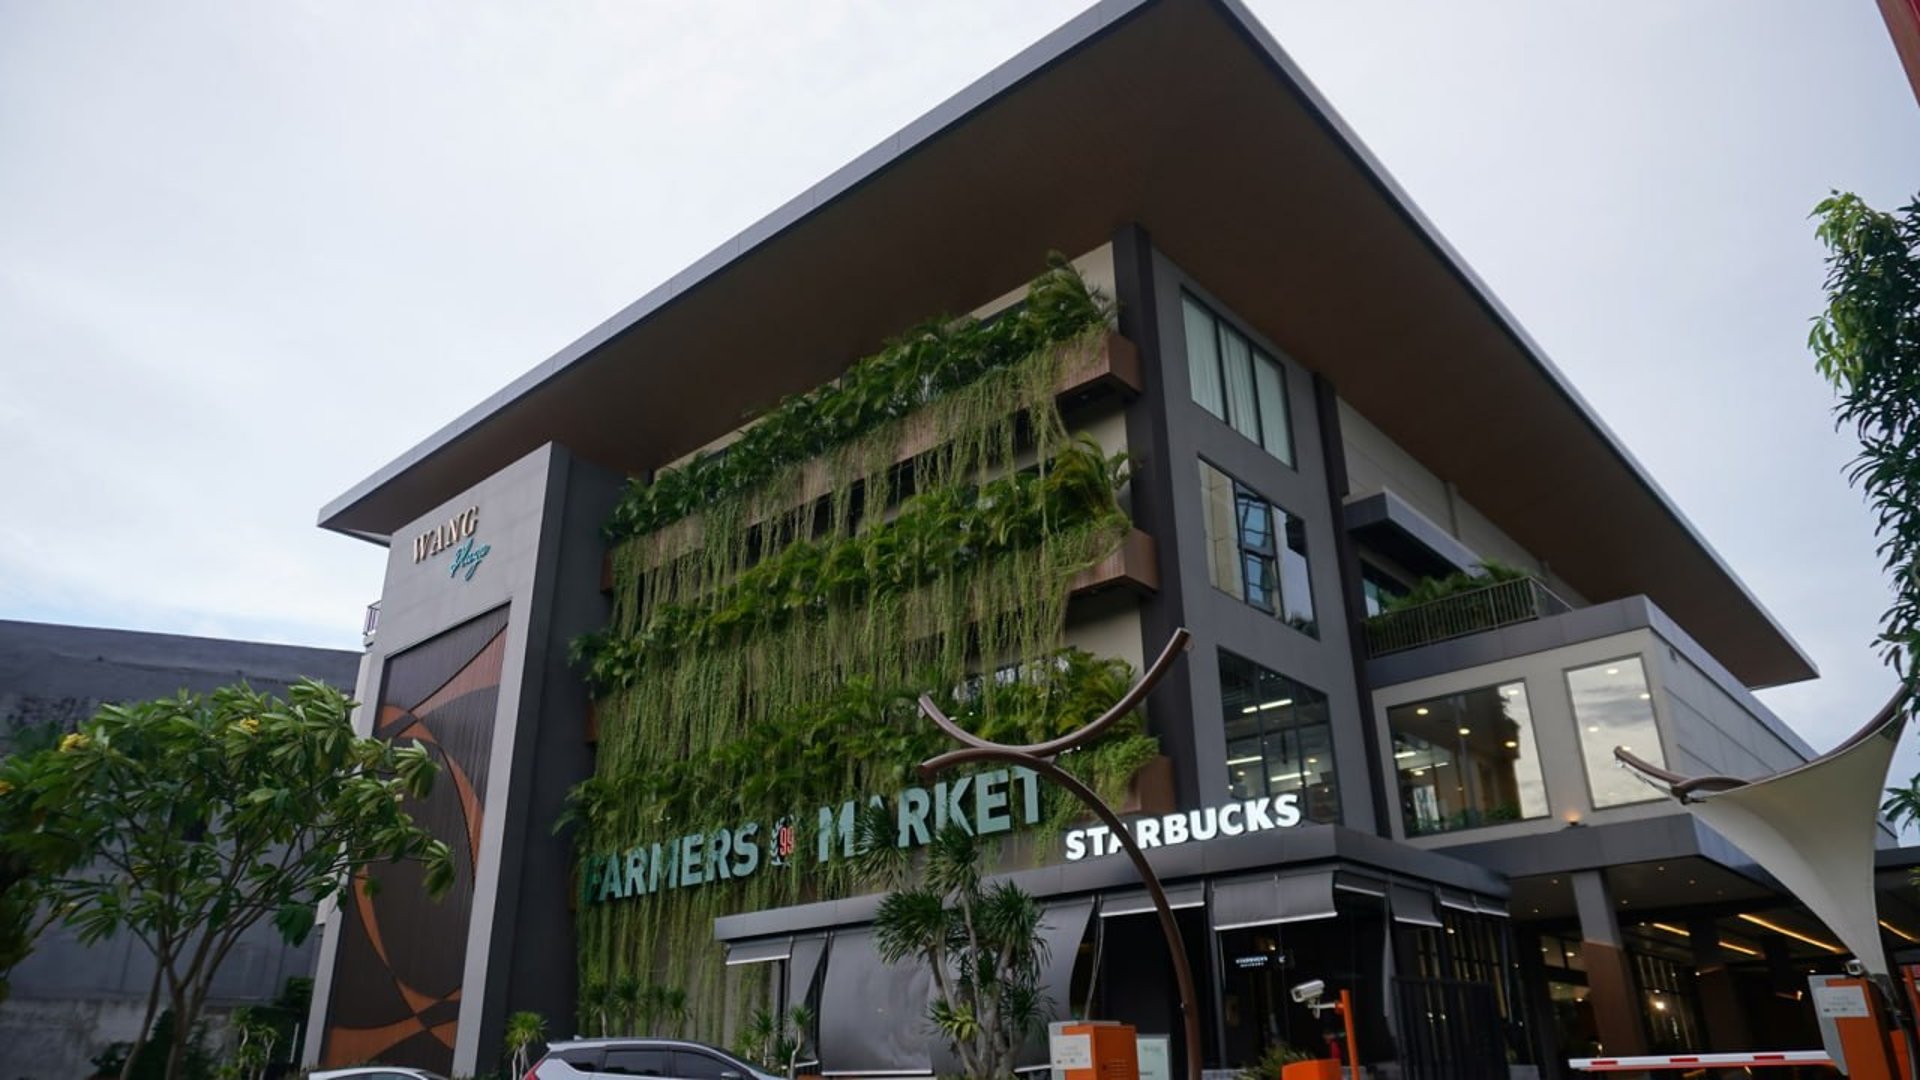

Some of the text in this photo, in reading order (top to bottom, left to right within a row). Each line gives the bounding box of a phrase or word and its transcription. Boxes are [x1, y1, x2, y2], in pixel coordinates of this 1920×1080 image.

[413, 505, 479, 564] WANG
[779, 825, 795, 857] 99
[818, 765, 1040, 864] MRKET
